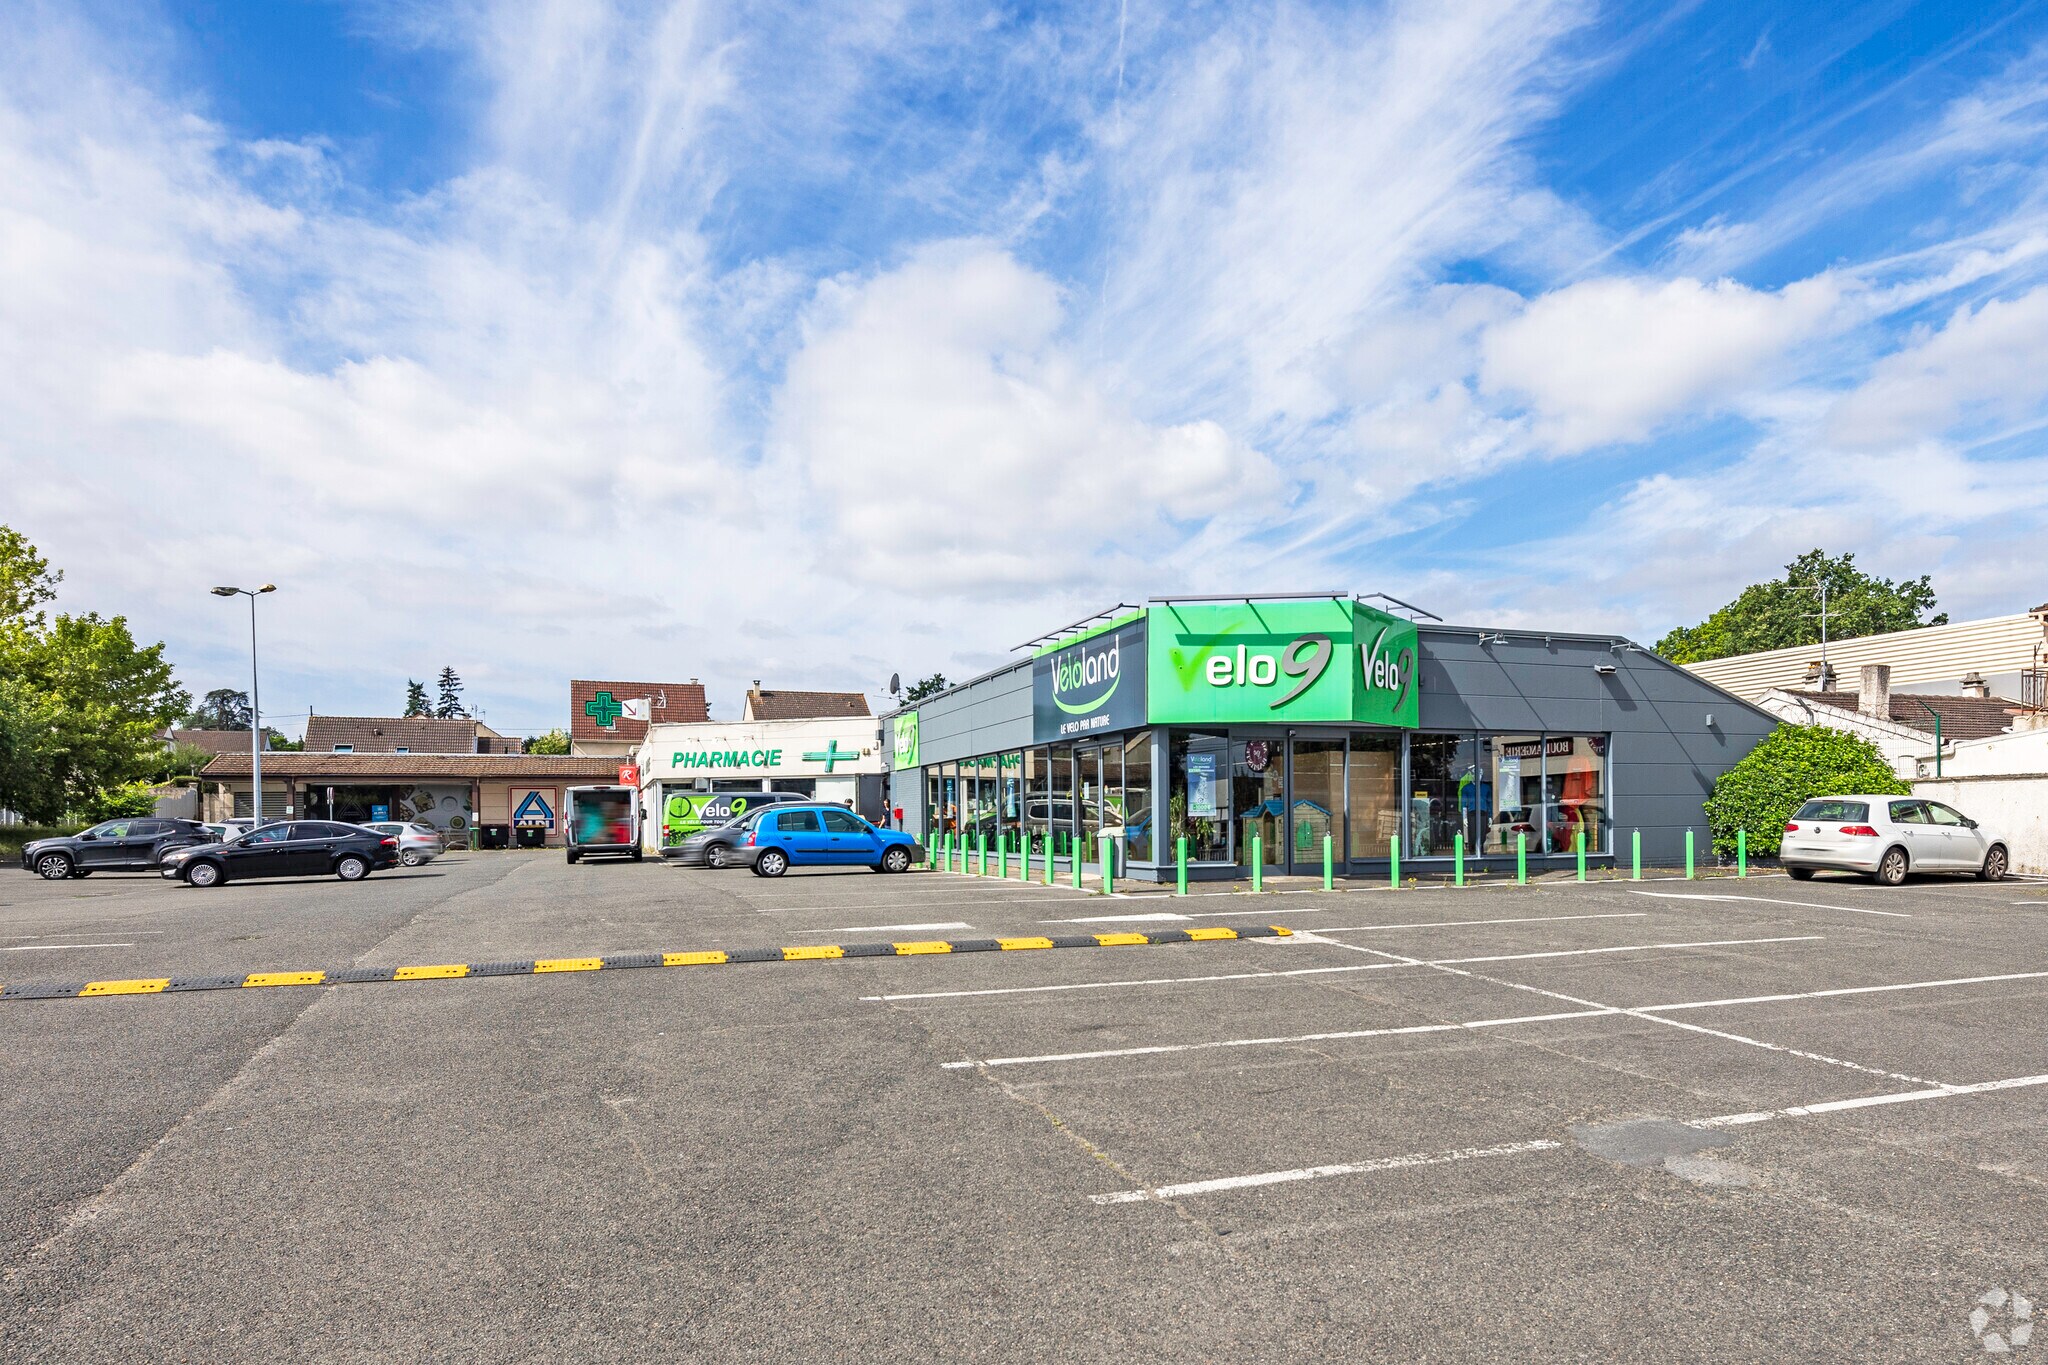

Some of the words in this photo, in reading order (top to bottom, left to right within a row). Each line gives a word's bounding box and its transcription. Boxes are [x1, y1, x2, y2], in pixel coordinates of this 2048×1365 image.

[1060, 723, 1067, 735] LE
[1079, 718, 1090, 731] PAR
[1090, 713, 1110, 729] NATURE
[671, 749, 783, 769] PHARMACIE
